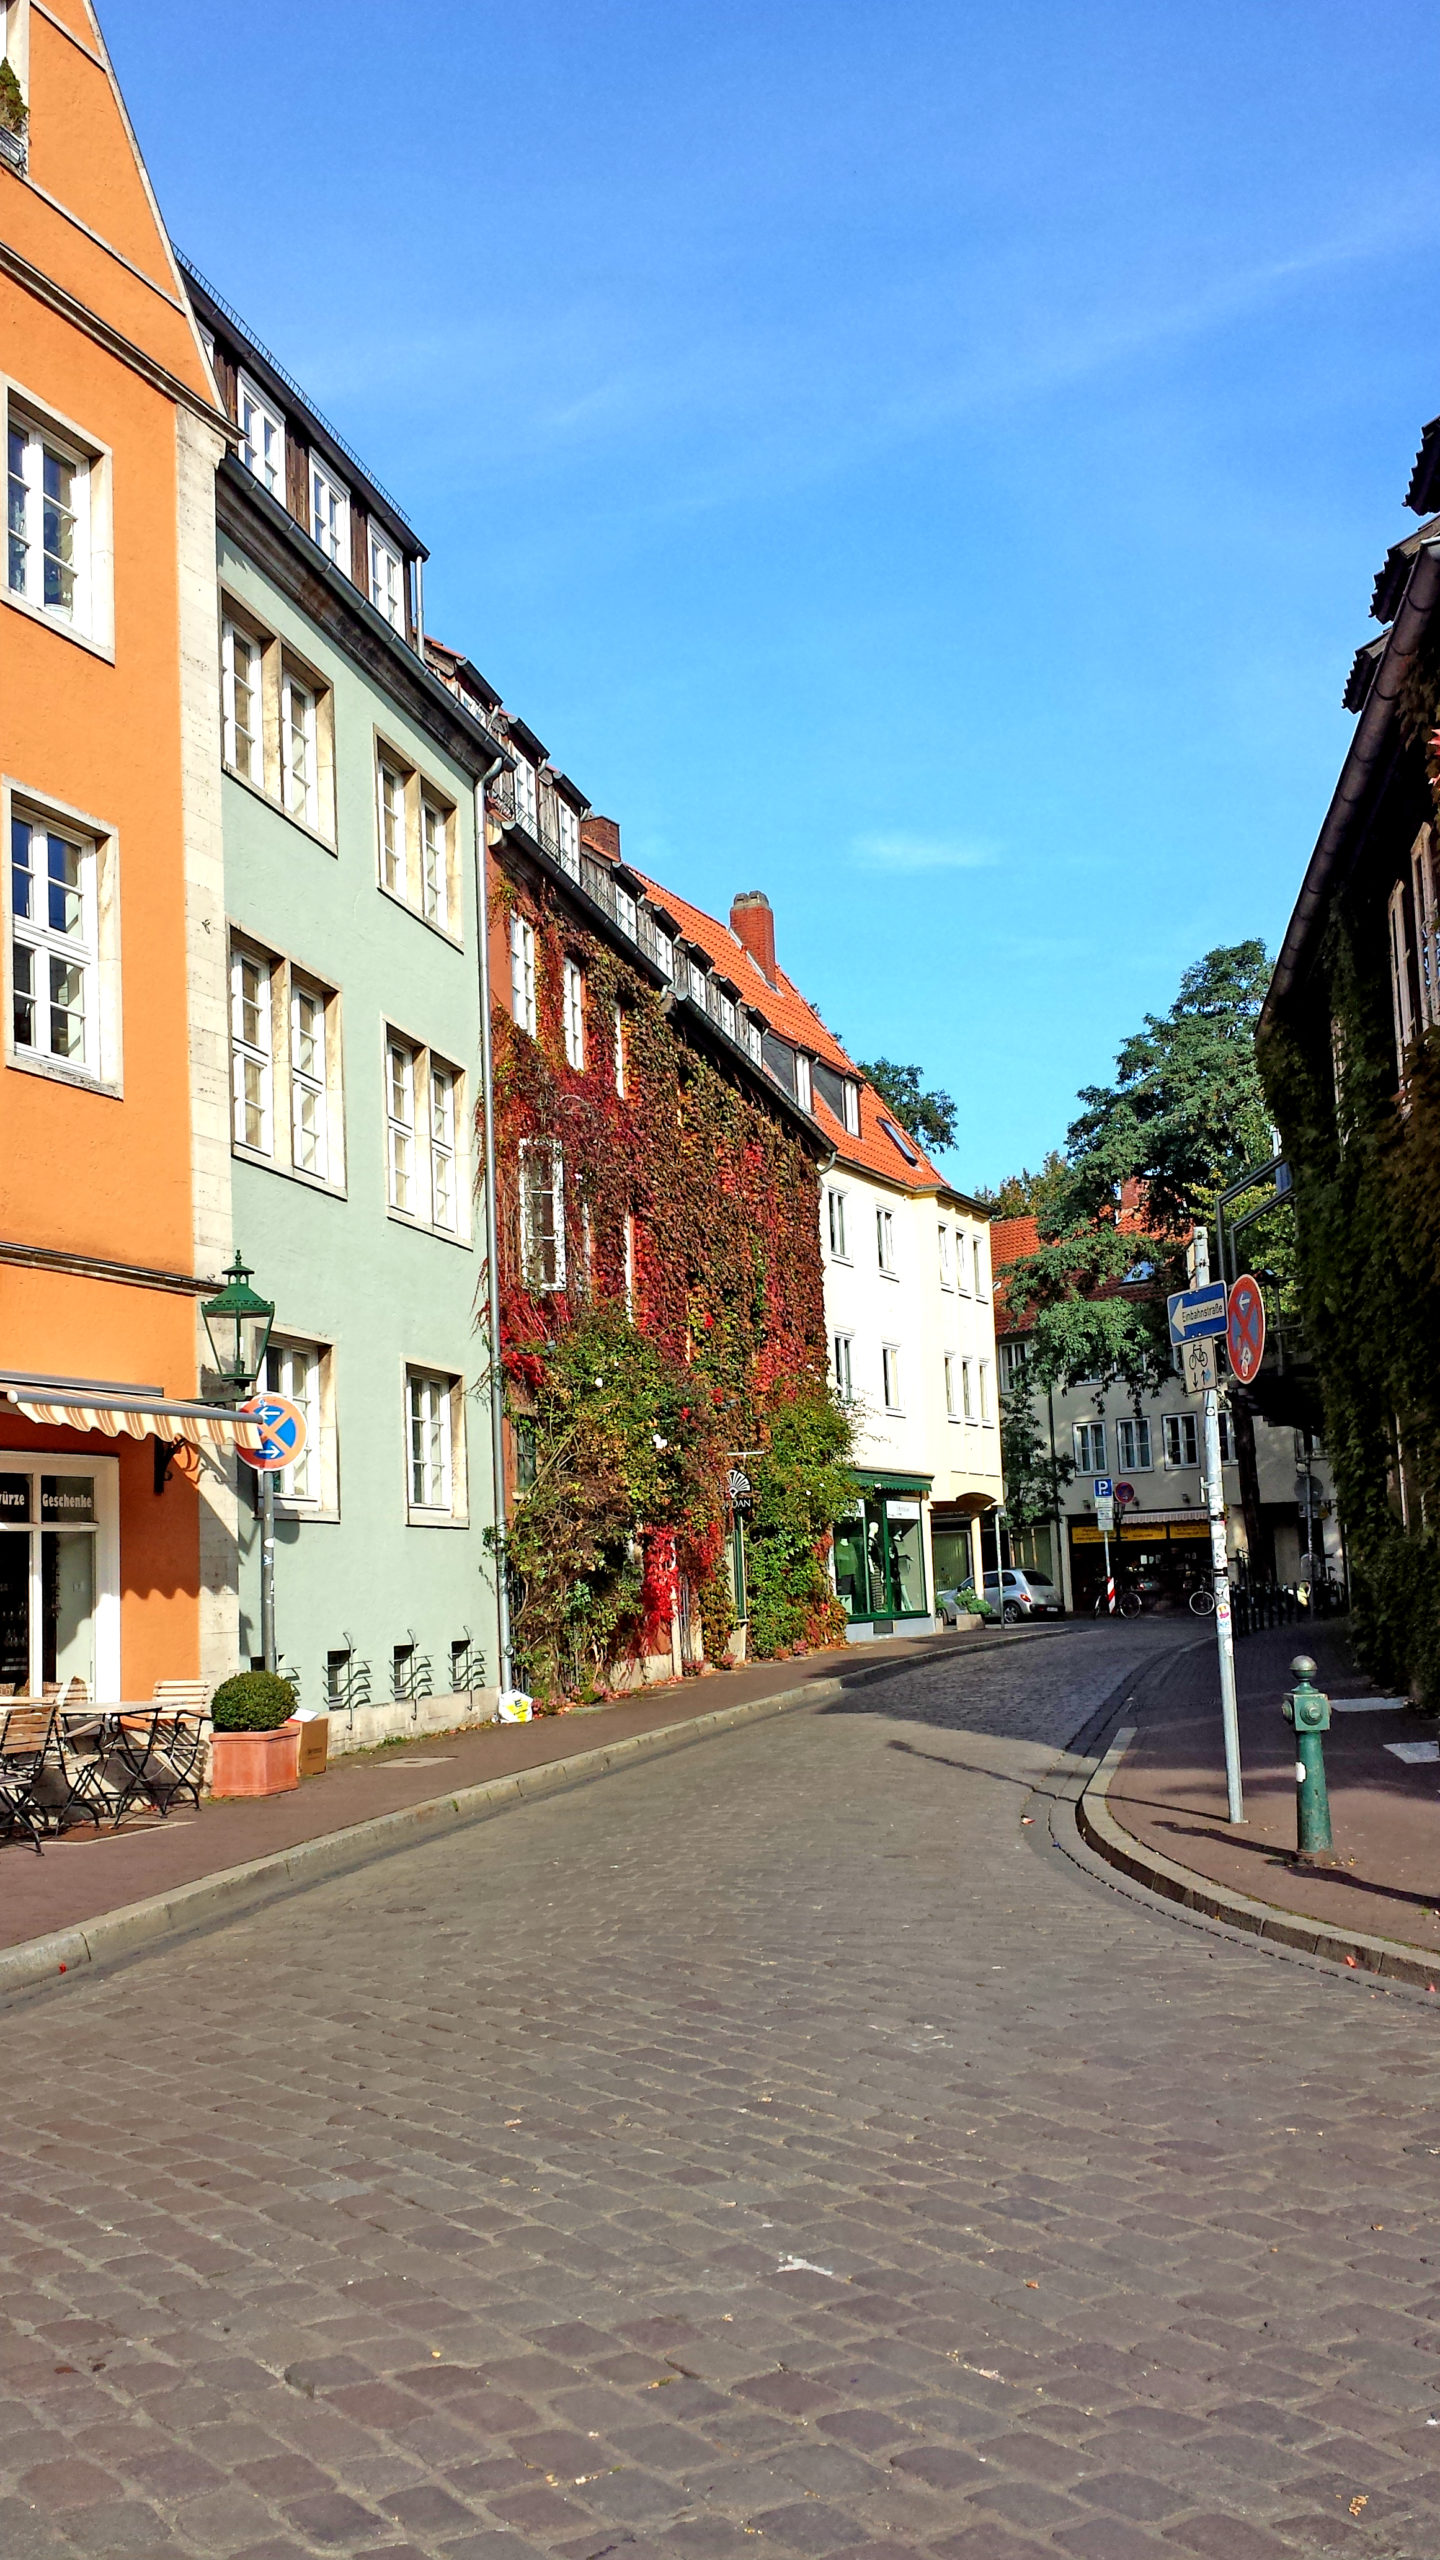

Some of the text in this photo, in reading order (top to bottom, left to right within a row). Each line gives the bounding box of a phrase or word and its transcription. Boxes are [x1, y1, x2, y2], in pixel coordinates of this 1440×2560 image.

[1182, 1303, 1223, 1322] Einbahnstraße
[1098, 1481, 1109, 1495] P
[0, 1491, 25, 1506] ürze
[42, 1493, 93, 1508] Geschenke
